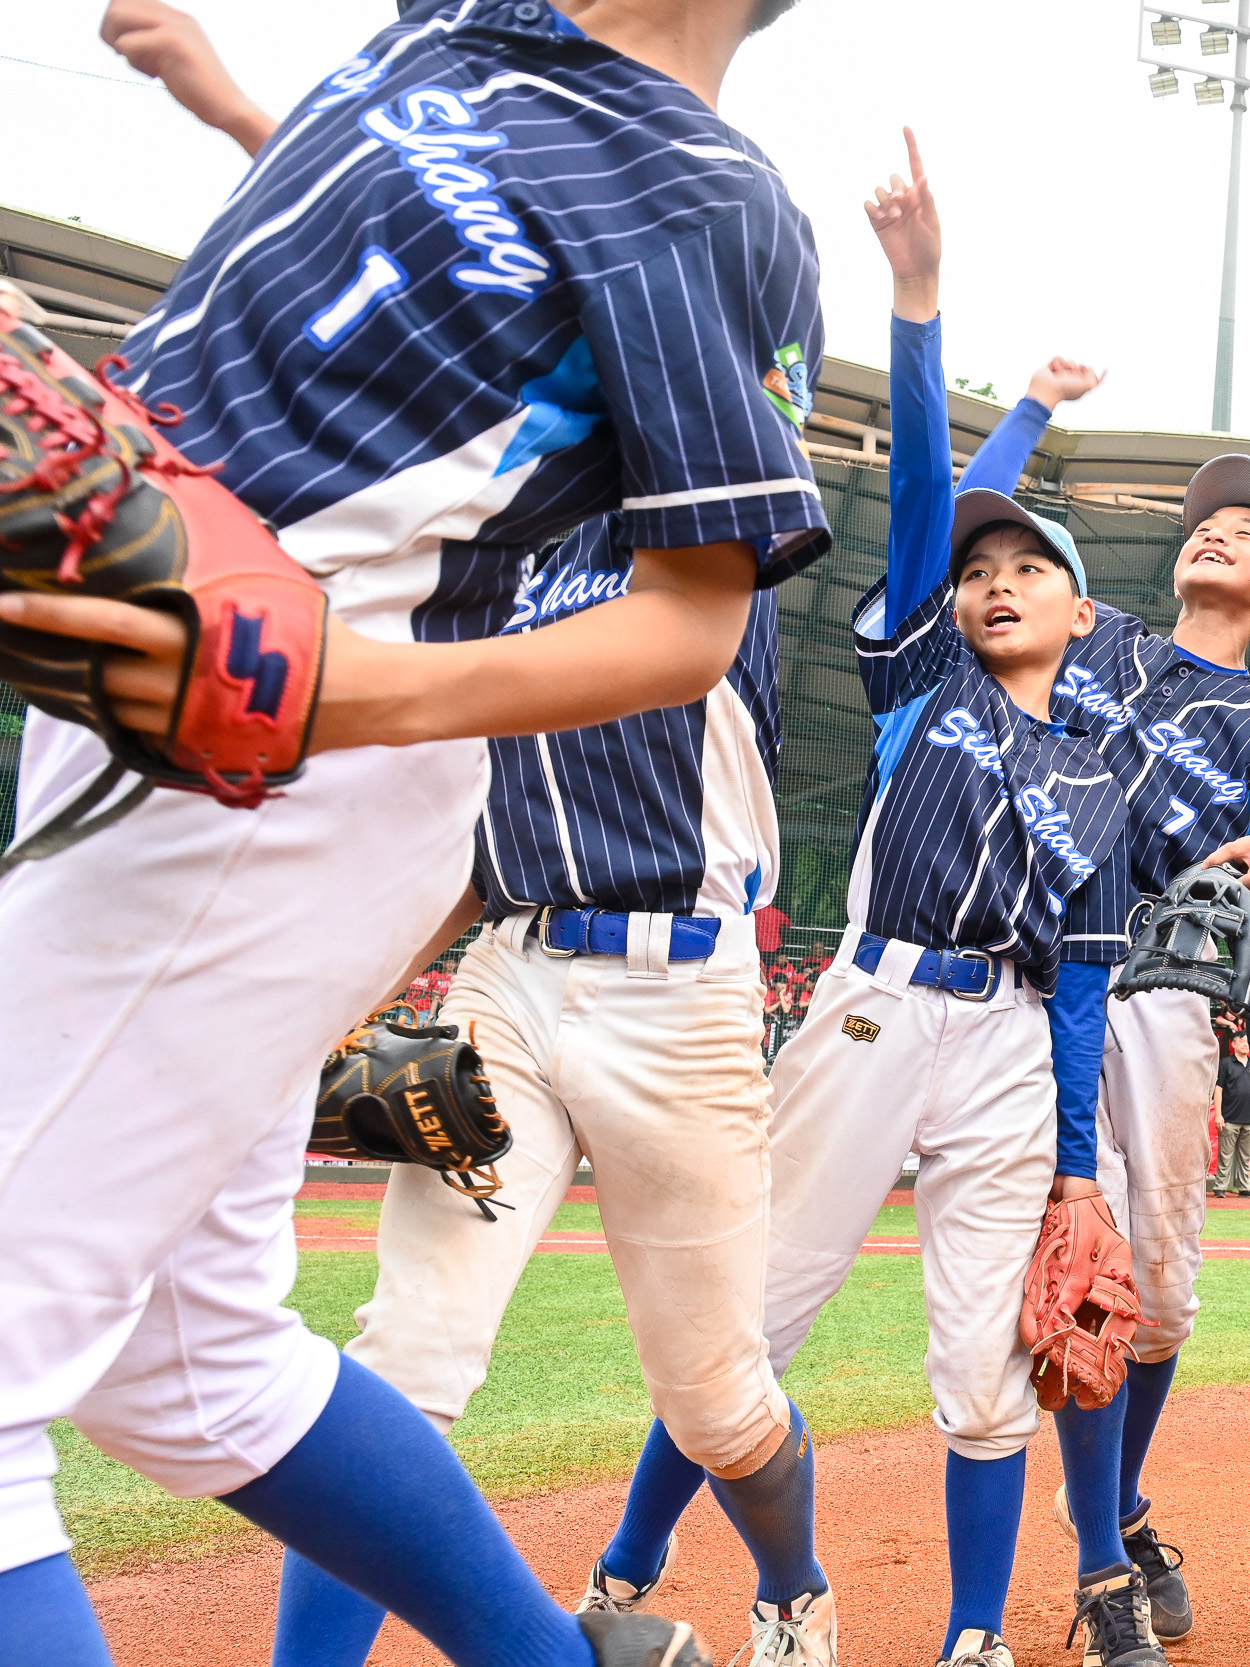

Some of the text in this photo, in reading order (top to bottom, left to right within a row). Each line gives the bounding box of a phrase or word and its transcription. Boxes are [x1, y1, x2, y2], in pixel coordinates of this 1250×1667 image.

[358, 85, 557, 300] Shang
[302, 245, 410, 351] 1
[1053, 663, 1247, 806] Siang Shang
[845, 1018, 877, 1036] ZETT
[404, 1090, 453, 1152] ZETT
